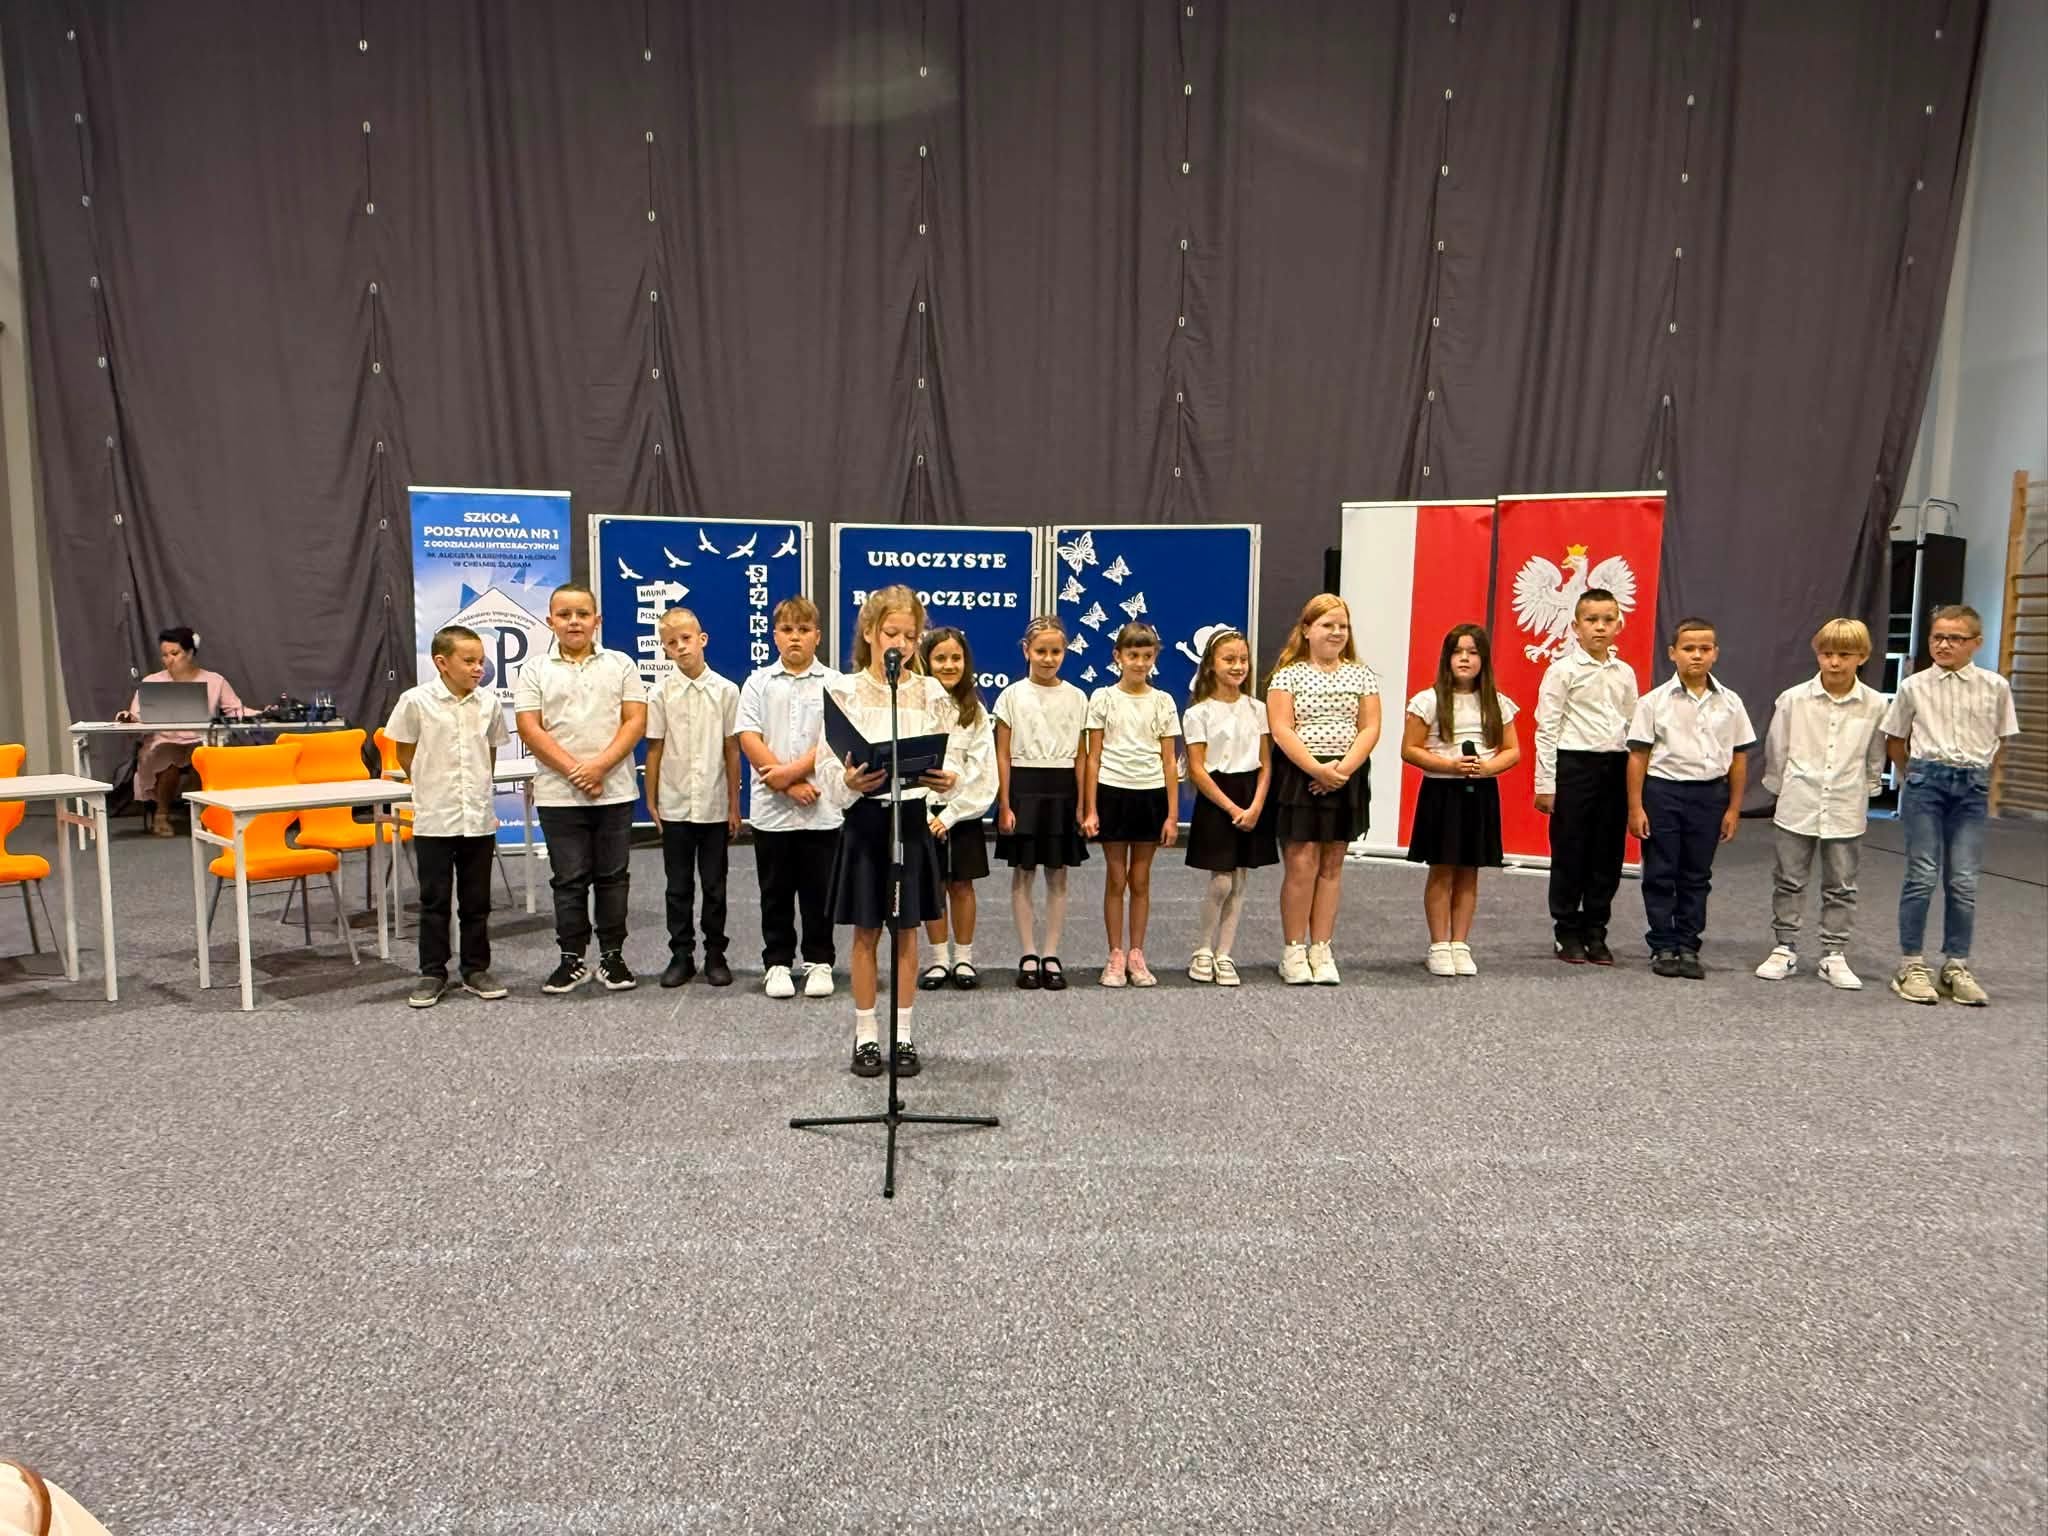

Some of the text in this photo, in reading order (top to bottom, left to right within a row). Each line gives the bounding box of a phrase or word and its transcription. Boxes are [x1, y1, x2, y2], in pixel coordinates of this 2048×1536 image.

[463, 512, 521, 524] SZKOŁA
[423, 526, 559, 539] PODSTAWOWA NR 1
[423, 540, 431, 548] Z
[867, 551, 1007, 569] UROCZYSTE
[852, 590, 1018, 610] ROCZĘCIE
[752, 566, 766, 658] SZKO
